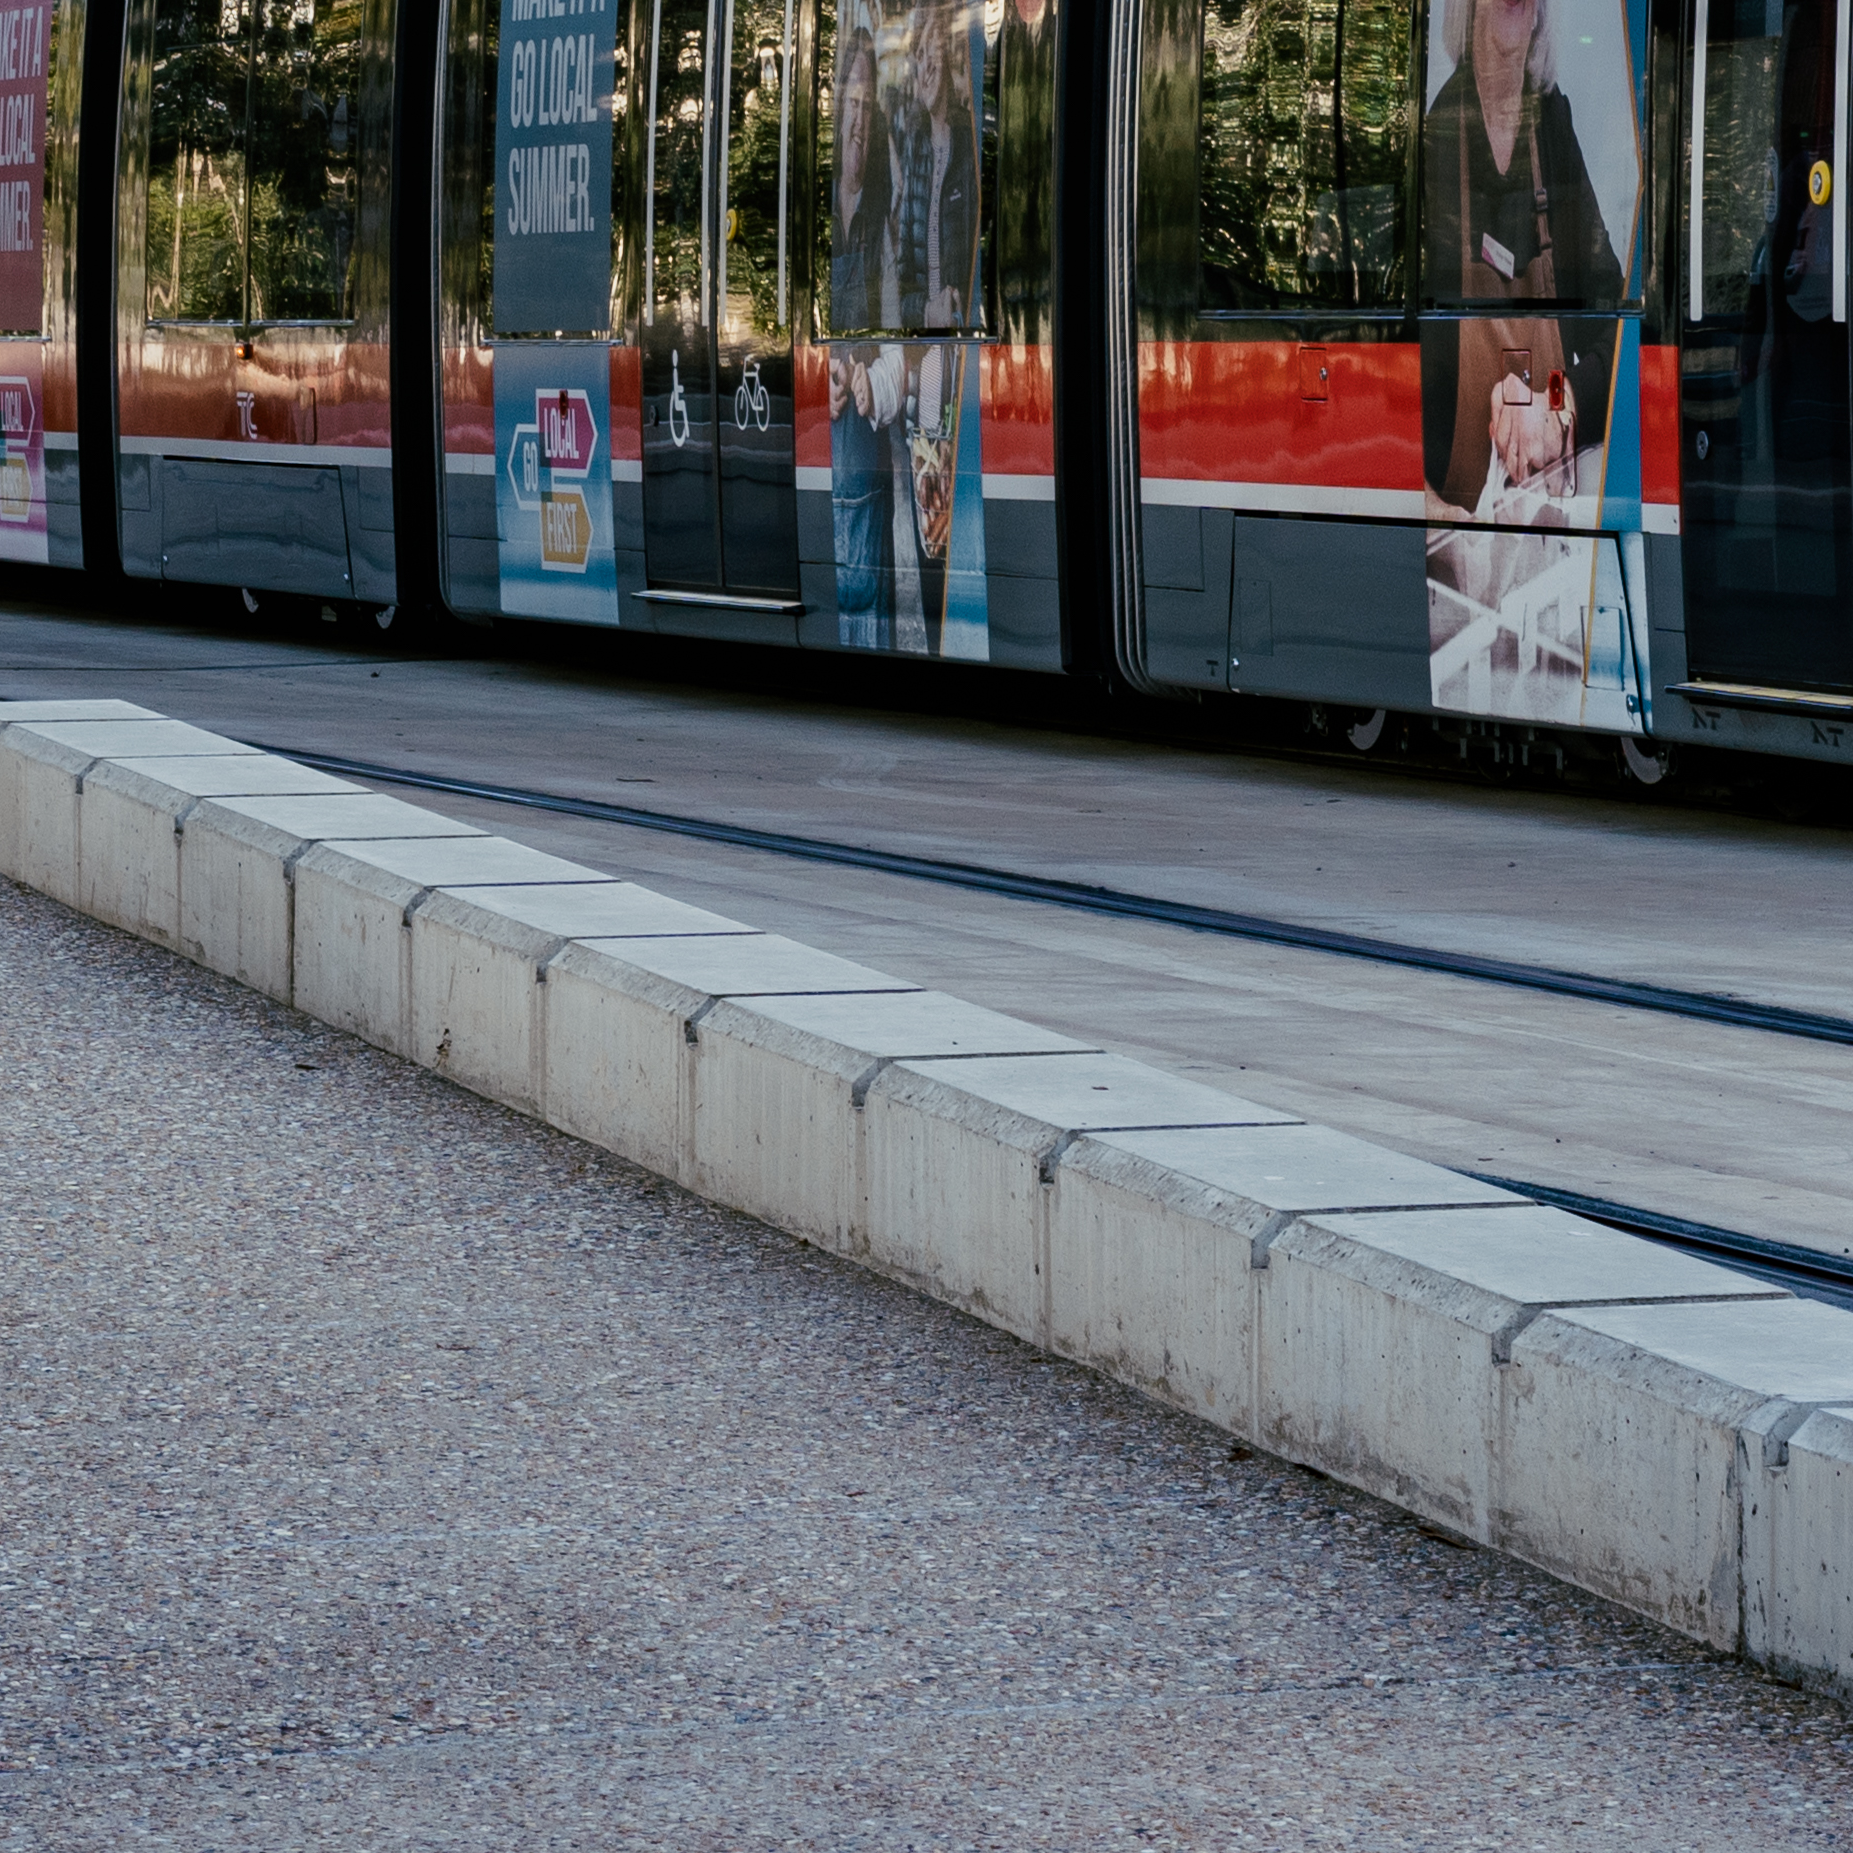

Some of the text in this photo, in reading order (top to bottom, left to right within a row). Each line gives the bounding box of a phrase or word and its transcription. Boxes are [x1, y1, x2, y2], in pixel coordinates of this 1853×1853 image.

[19, 7, 34, 79] IT
[32, 6, 44, 78] A
[510, 34, 598, 129] GO LOCAL
[508, 143, 595, 236] SUMMER.
[0, 391, 24, 432] LOCAL
[236, 391, 258, 440] TC
[543, 407, 579, 460] LOCAL
[523, 441, 539, 492] GO
[546, 501, 578, 555] FIRST
